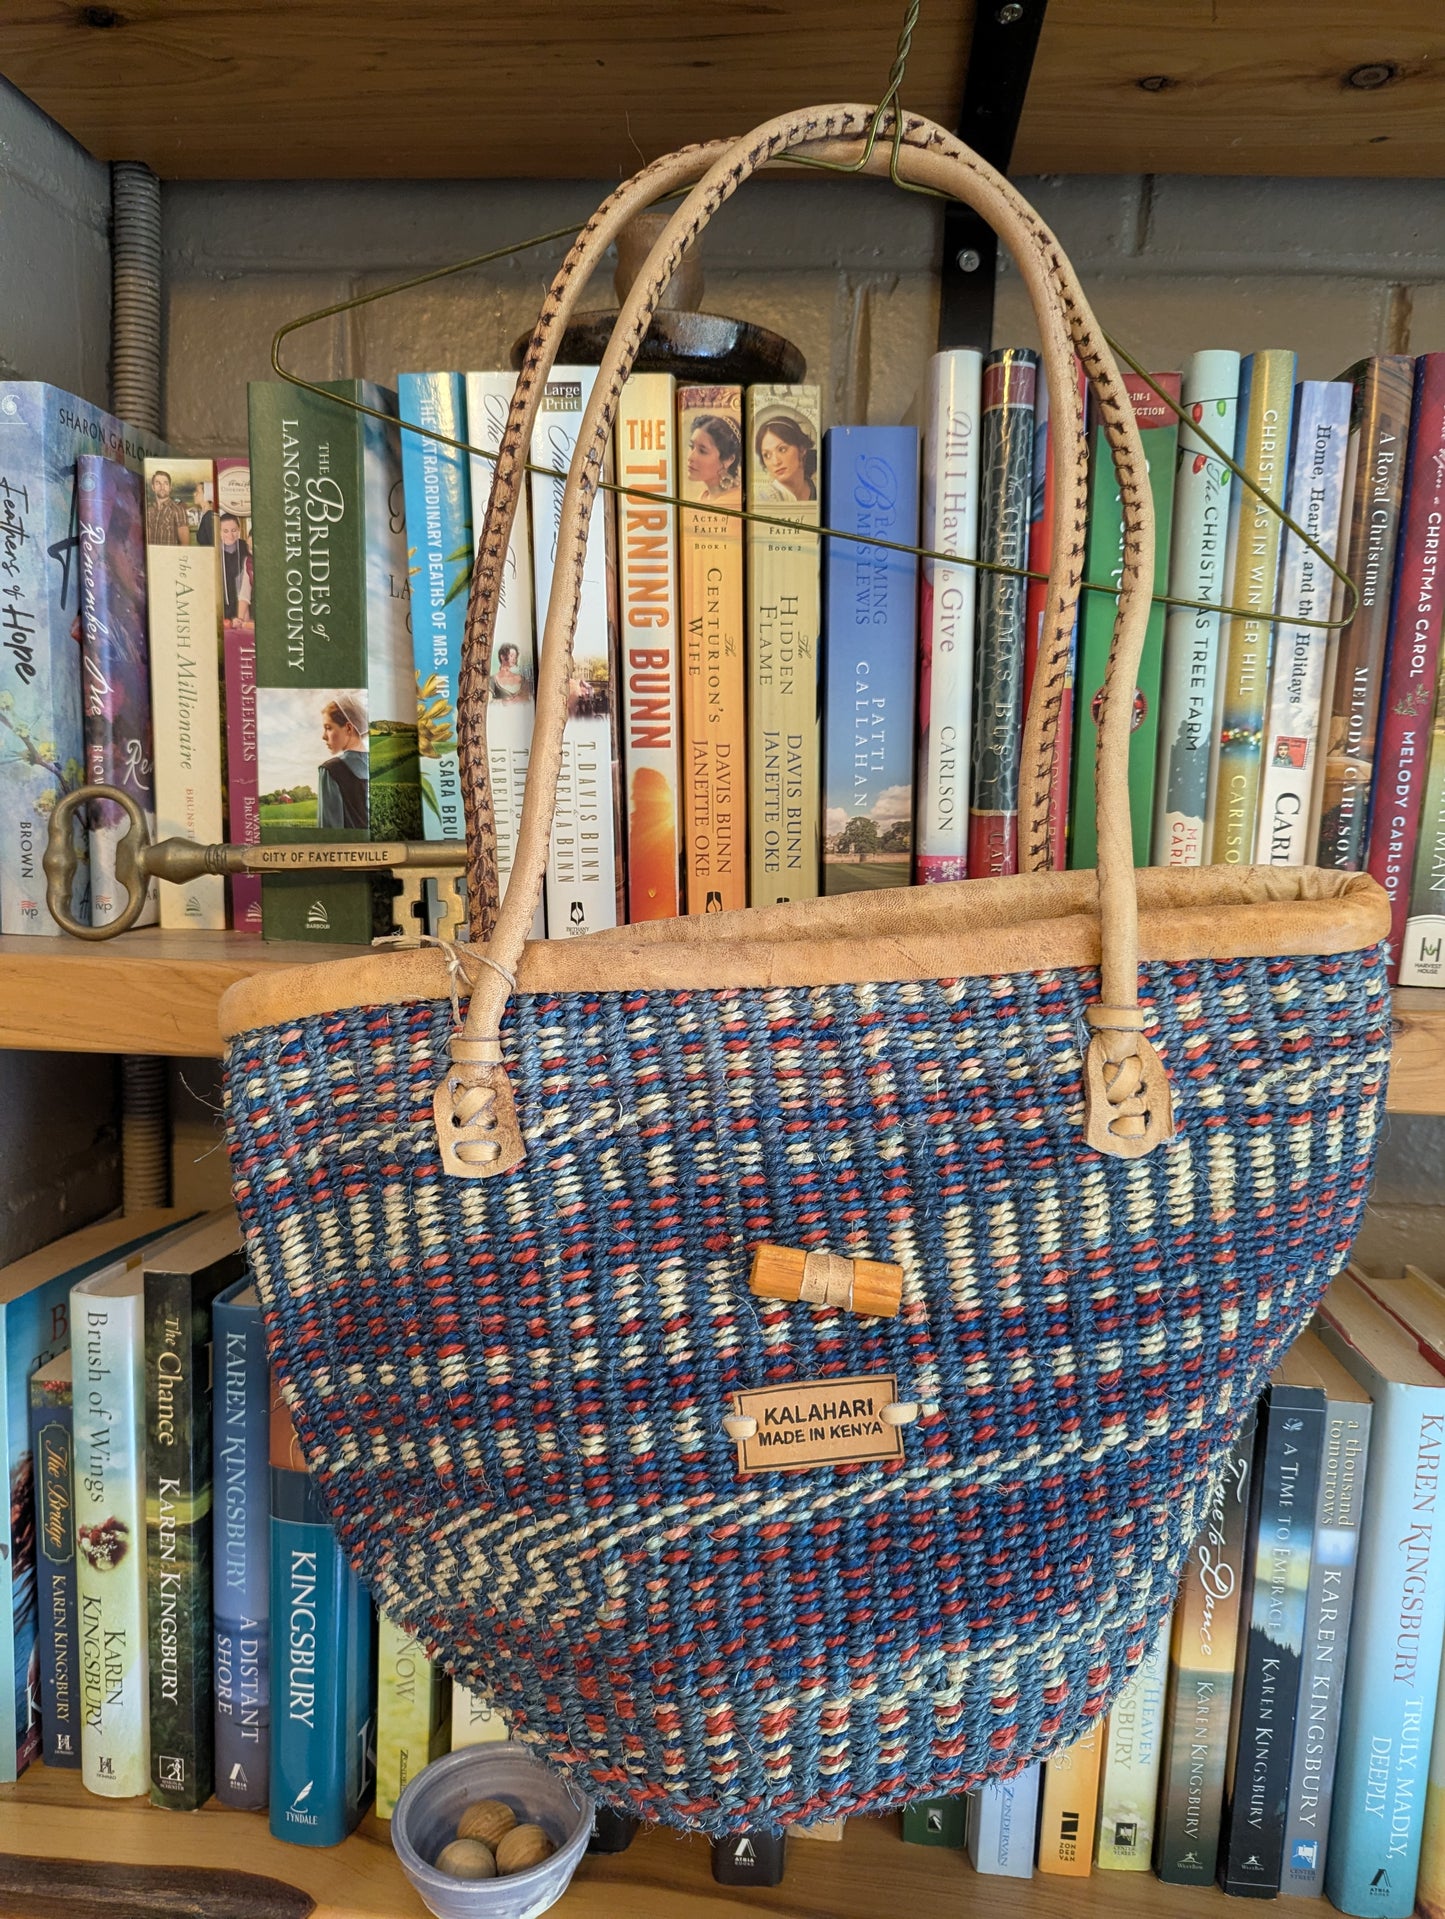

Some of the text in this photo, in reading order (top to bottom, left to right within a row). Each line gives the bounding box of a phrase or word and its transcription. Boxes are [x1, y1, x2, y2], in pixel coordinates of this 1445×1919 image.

[59, 408, 106, 443] SHARON
[544, 384, 580, 396] Large
[545, 398, 579, 410] Print
[944, 407, 973, 460] All
[945, 471, 967, 480] I
[1309, 425, 1333, 480] Home,
[0, 476, 30, 578] Feathers
[282, 419, 304, 672] LANCASTER COUNTY
[305, 442, 344, 641] THE BRIDES of
[420, 399, 450, 699] THE XTRAORDINARY DEATHS OF MRS. KIP
[625, 419, 669, 628] THE TURNING
[692, 514, 718, 523] ACTS
[694, 525, 727, 533] FAITH
[769, 526, 801, 535] FAITH
[854, 454, 898, 626] BECOMING
[1251, 535, 1267, 556] IN
[1363, 431, 1396, 607] A Royal Christmas
[1417, 511, 1442, 613] CHRISTMAS
[79, 519, 115, 717] Remember Me
[855, 561, 872, 626] LEWIS
[940, 587, 964, 653] Give
[995, 507, 1020, 682] CHRISTMAS
[1185, 461, 1222, 751] The CHRISTMAS TREE FARM
[1300, 561, 1315, 593] and
[2, 603, 37, 685] Hope
[175, 555, 199, 771] The AMISH Millionaire
[688, 616, 704, 676] WIFE
[707, 567, 724, 723] CENTURION'S
[724, 632, 737, 658] The
[759, 605, 778, 686] FLAME
[780, 596, 799, 696] HIDDEN
[798, 631, 812, 660] The
[1239, 653, 1257, 696] HILL
[1287, 632, 1311, 704] Holidays
[1409, 618, 1430, 678] CAROL
[238, 641, 258, 762] THE SEEKERS
[629, 648, 671, 749] BUNN
[854, 661, 871, 807] CALLAHAN
[871, 697, 886, 772] PATTI
[439, 761, 455, 798] SARA
[490, 749, 512, 875] ISABELLA BUNN
[577, 742, 601, 883] T. DAVIS BUNN
[692, 740, 710, 877] JANETTE OKE
[715, 743, 732, 874] DAVIS BUNN
[763, 731, 780, 873] JANETTE OKE
[786, 734, 802, 870] DAVIS BUNN
[937, 726, 957, 831] CARLSON
[1334, 667, 1369, 867] MELODY CARLSON
[1384, 731, 1416, 902] MELODY CARLSON
[20, 821, 34, 879] BROWN
[262, 849, 389, 863] CITY OF FAYETTEVILLE
[556, 837, 575, 884] BUNN
[84, 1311, 114, 1503] Brush of Wings
[158, 1317, 184, 1447] The Chance
[764, 1398, 874, 1426] KALAHARI
[219, 1331, 248, 1594] KAREN KINGSBURY
[758, 1421, 883, 1447] MADE IN KENYA
[1322, 1419, 1344, 1525] tomorrows
[1337, 1420, 1362, 1527] a thousand
[47, 1480, 71, 1548] Bridge
[1268, 1442, 1299, 1629] A TIME TO EMBRACE
[1393, 1413, 1445, 1688] KAREN KINGSBURY
[159, 1477, 181, 1705] KAREN KINGSBURY
[289, 1549, 318, 1729] KINGSBURY
[1198, 1545, 1235, 1656] Dance
[52, 1574, 71, 1725] KAREN KINGSBURY
[82, 1595, 103, 1735] KINGSBURY
[103, 1628, 127, 1706] KAREN
[217, 1634, 233, 1716] SHORE
[239, 1615, 260, 1744] A DISTANT
[1298, 1570, 1342, 1828] KAREN KINGSBURY
[1138, 1688, 1160, 1765] HEAVEN
[1183, 1681, 1214, 1840] KAREN KINGSBURY
[1247, 1658, 1281, 1830] KAREN KINGSBURY
[1364, 1736, 1393, 1818] DEEPLY
[1385, 1695, 1424, 1859] TRULY, MADLY,
[285, 1810, 318, 1826] TYNDALE
[1000, 1786, 1015, 1867] ZONDERVAN
